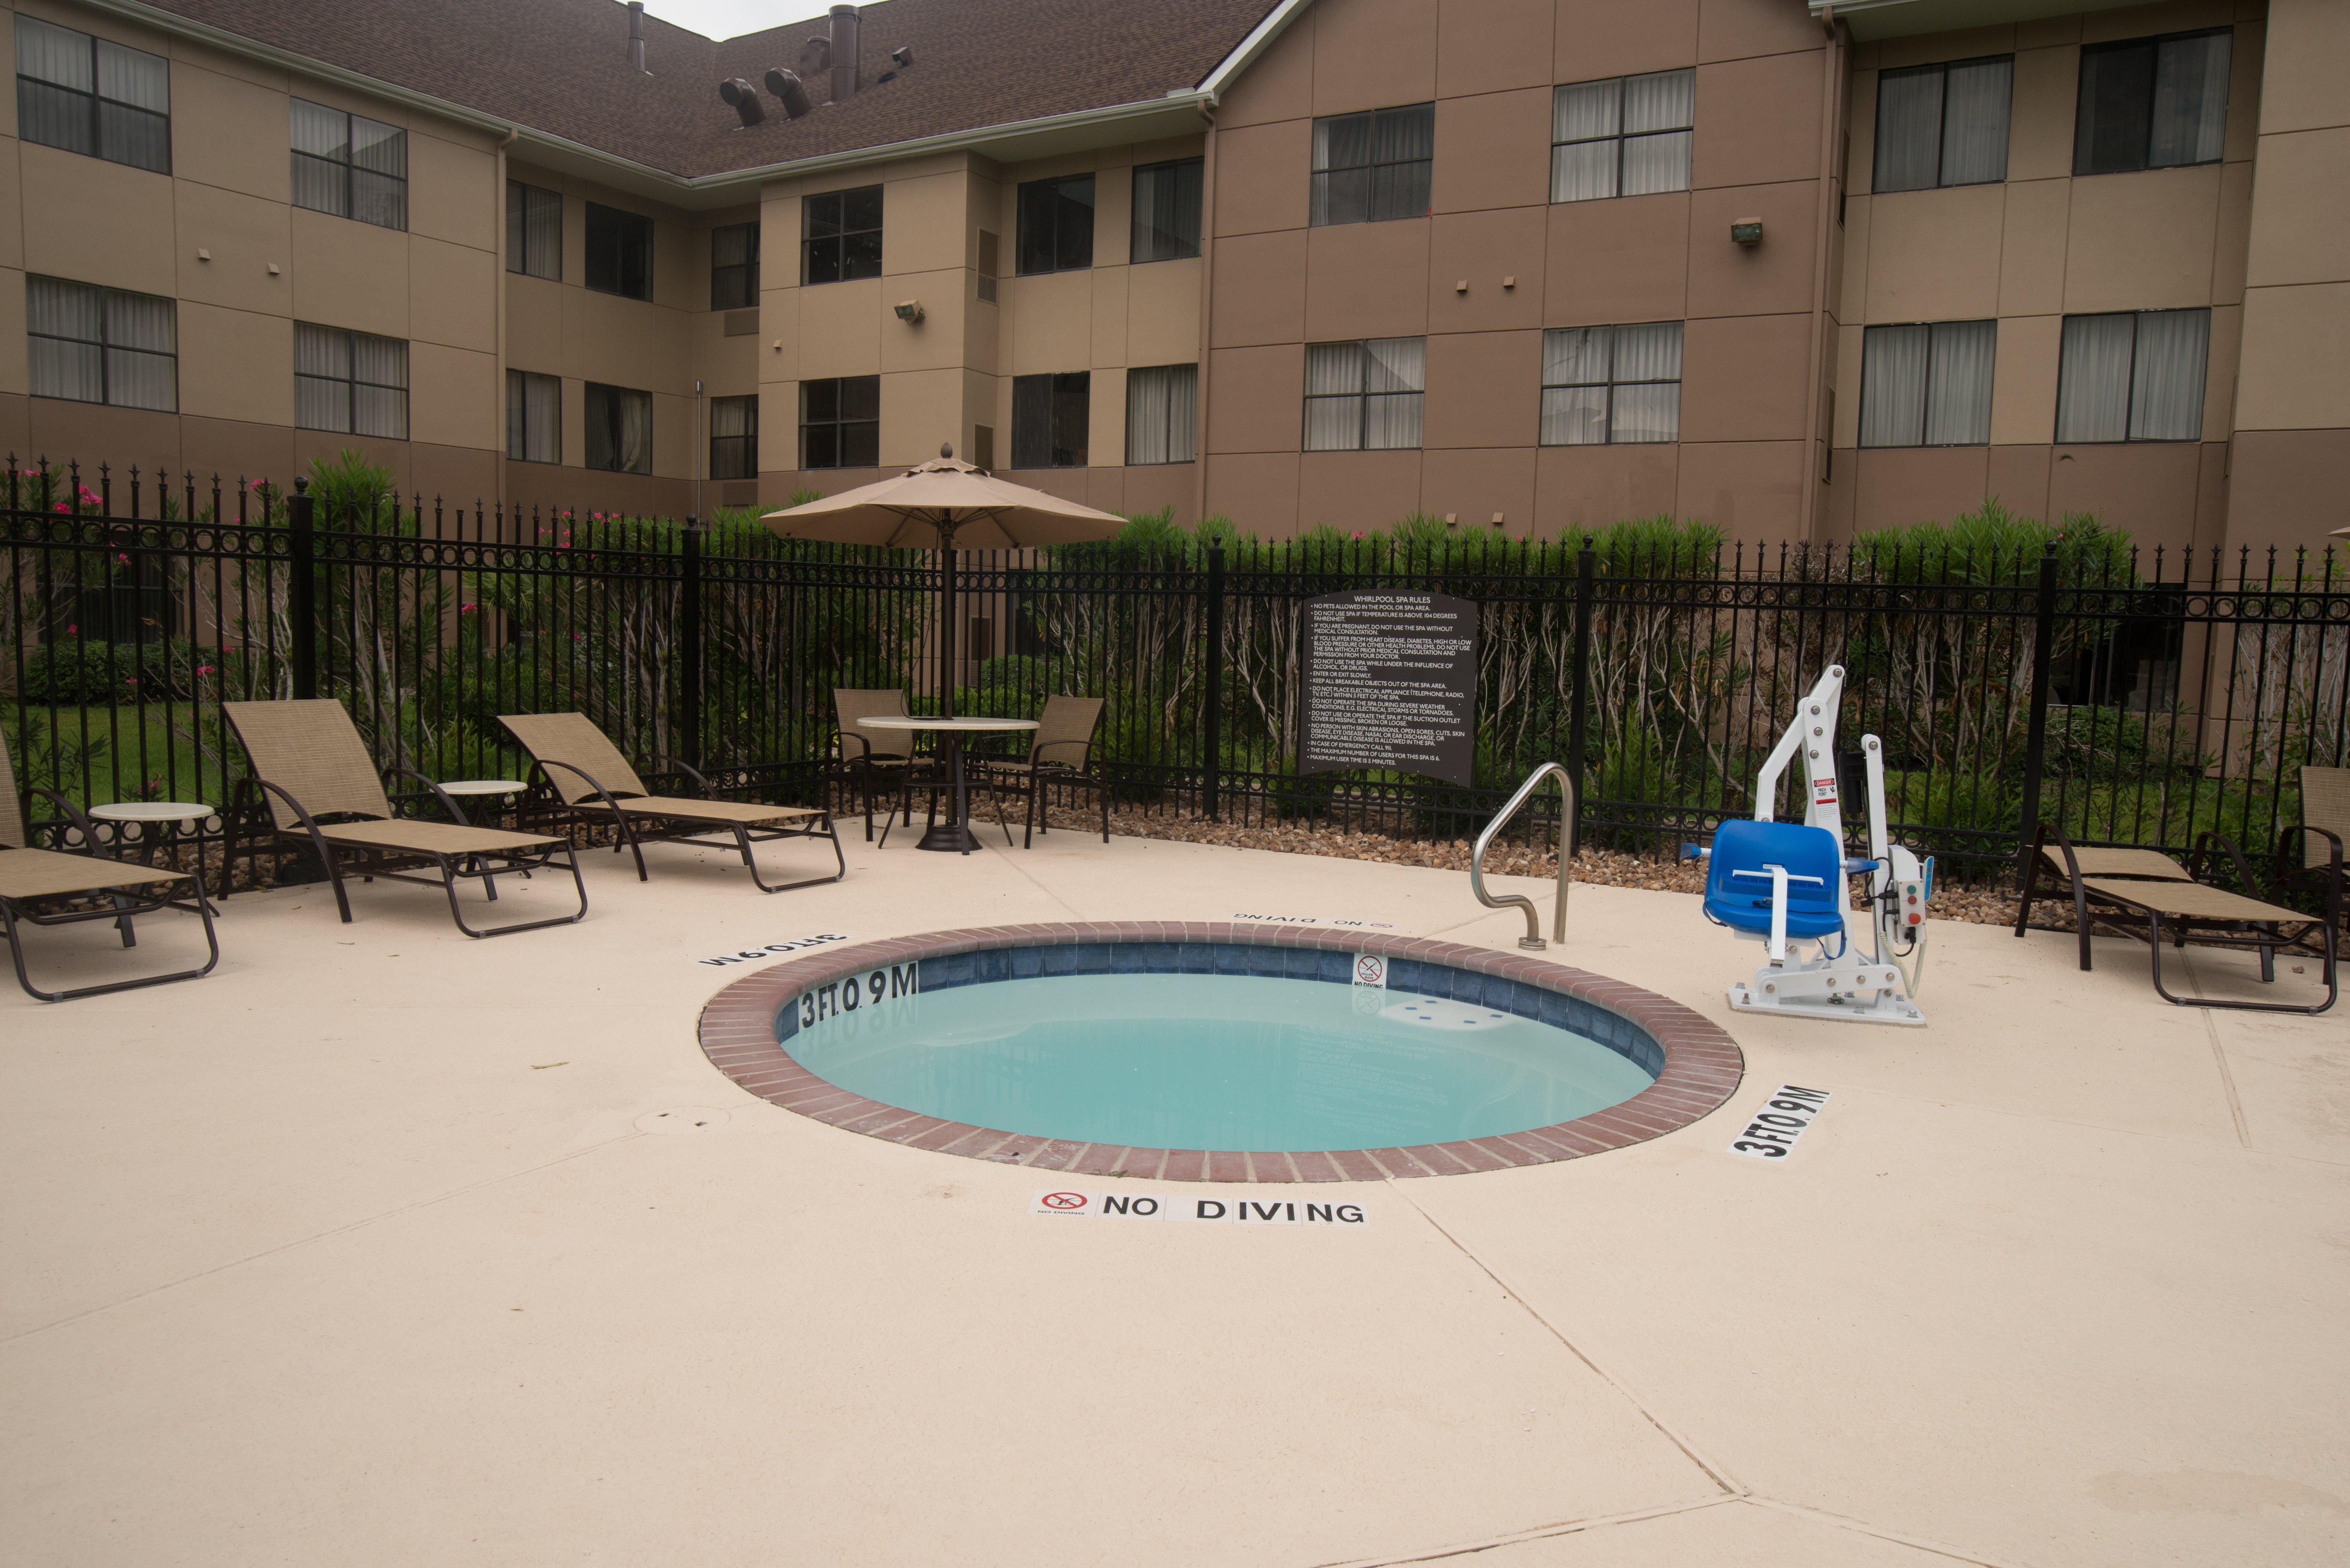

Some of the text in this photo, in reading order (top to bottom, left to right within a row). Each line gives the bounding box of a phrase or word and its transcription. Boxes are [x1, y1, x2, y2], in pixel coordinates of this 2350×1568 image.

[1234, 914, 1316, 923] DIVING
[1103, 1196, 1364, 1223] NO DIVING
